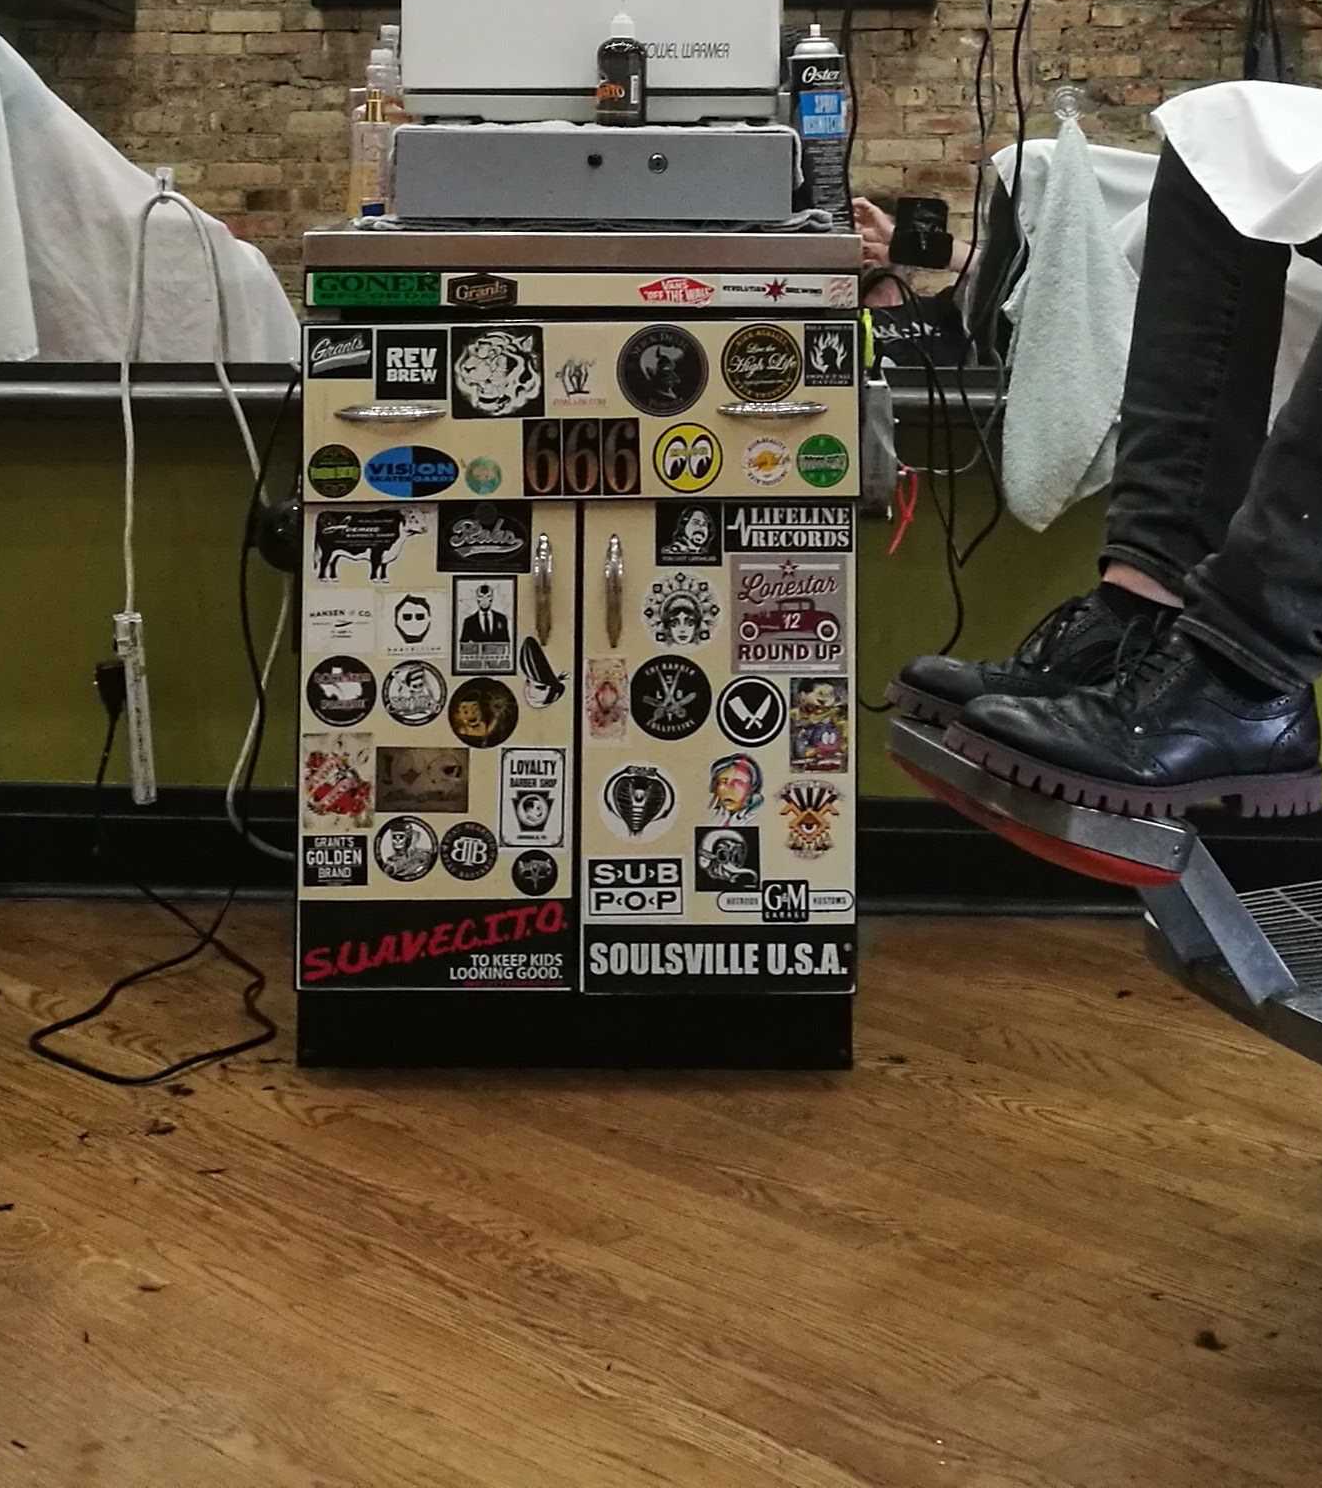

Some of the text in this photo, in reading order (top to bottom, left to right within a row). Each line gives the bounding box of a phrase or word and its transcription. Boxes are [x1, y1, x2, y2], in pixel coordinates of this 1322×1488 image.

[681, 43, 730, 59] WARMER
[802, 66, 840, 83] Oster
[317, 275, 438, 291] GONER
[665, 290, 684, 302] THE
[386, 348, 437, 368] REV
[728, 355, 765, 378] High
[386, 369, 437, 382] BREW
[367, 463, 454, 476] VISION
[751, 508, 850, 525] LIFELINE
[751, 530, 850, 548] RECORDS
[738, 573, 840, 606] Lonestar
[738, 643, 842, 661] ROUND UP
[510, 759, 557, 776] LOYALTY
[510, 778, 557, 788] BARBER SHOP
[314, 837, 354, 847] GRANT'S
[306, 849, 362, 865] GOLDEN
[318, 867, 352, 878] BRAND
[471, 954, 563, 966] TO KEEP KIDS
[589, 942, 849, 975] SOULSVILLE U.S.A.
[450, 967, 563, 980] LOOKING GOOD.
